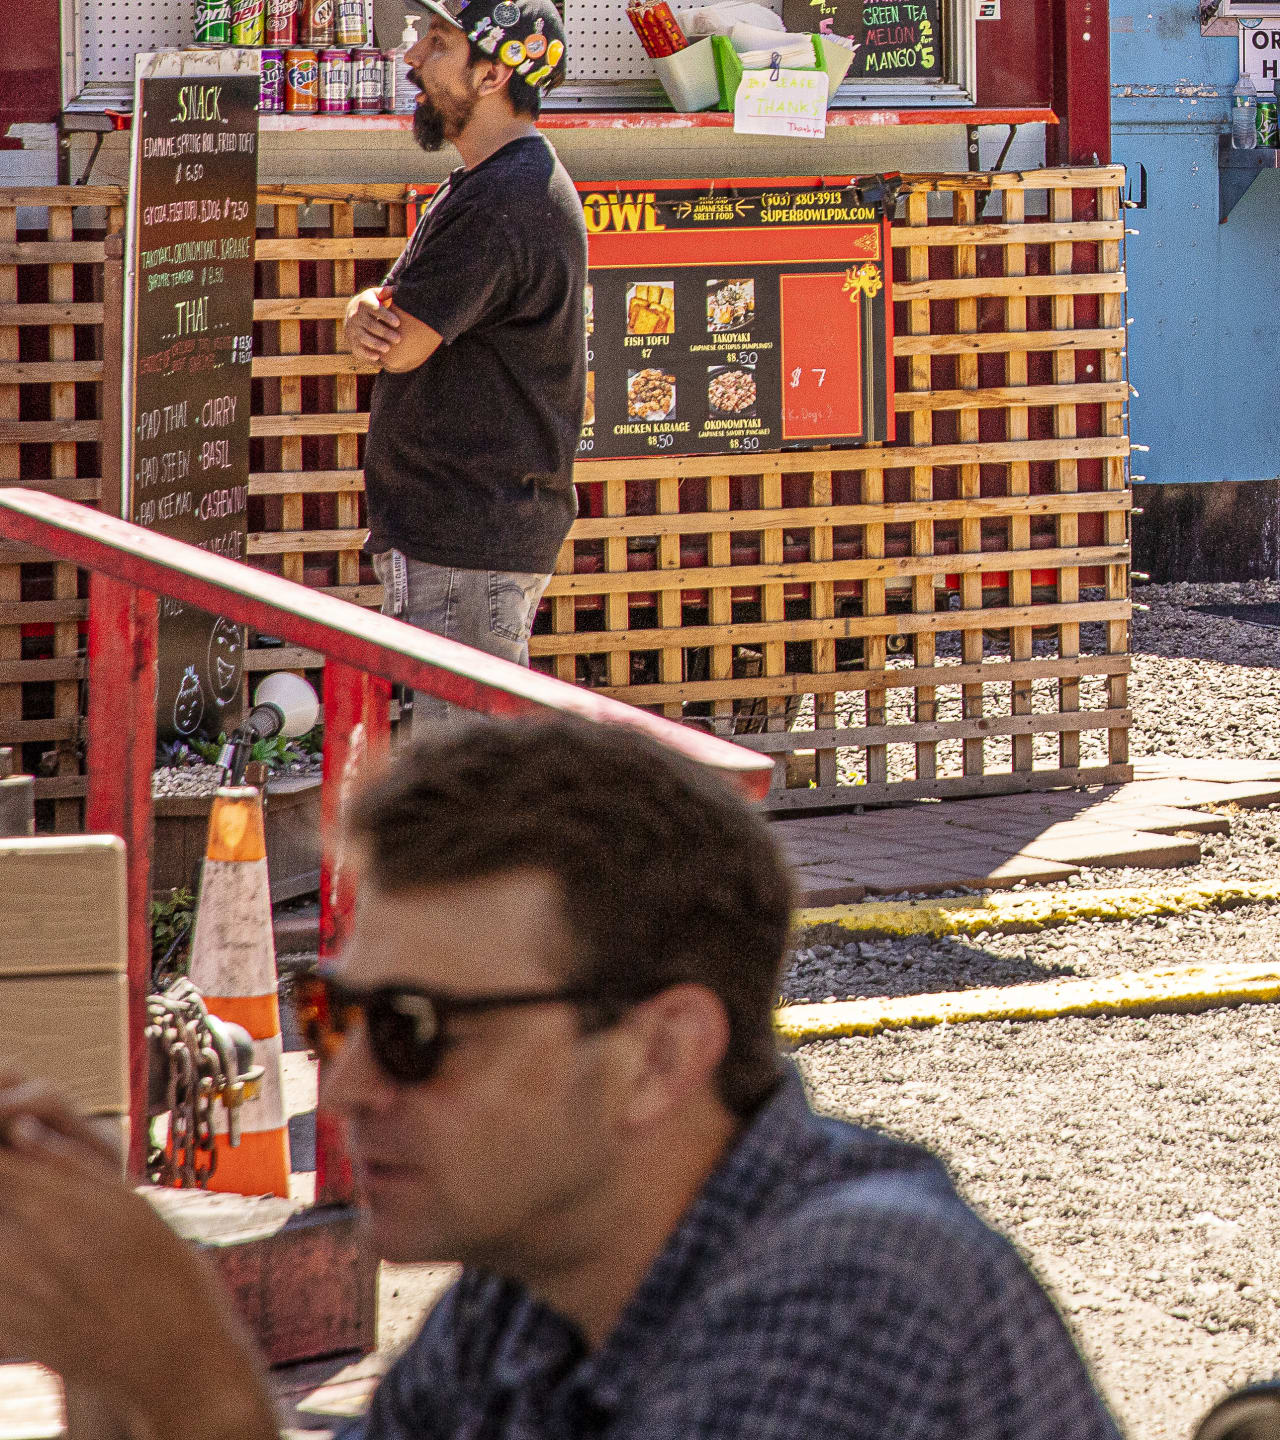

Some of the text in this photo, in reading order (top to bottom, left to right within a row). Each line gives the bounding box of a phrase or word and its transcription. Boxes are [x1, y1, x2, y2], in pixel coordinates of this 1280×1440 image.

[820, 3, 838, 15] for
[863, 4, 928, 26] GREEN TEA
[865, 26, 915, 46] MELON
[919, 19, 933, 36] 2
[865, 48, 917, 72] MANGO
[921, 46, 935, 69] 5
[288, 66, 318, 89] Fant
[178, 84, 222, 122] SNACK
[584, 192, 666, 232] OWL
[715, 212, 734, 220] FOOD
[760, 207, 876, 223] SUPERBOWLPDX.COM
[175, 295, 209, 336] THAI
[623, 335, 670, 347] FISH TOFU
[712, 332, 751, 344] TAKOYAKI
[641, 348, 653, 359] $7
[140, 401, 189, 441] PAD THAI
[202, 395, 238, 428] CURRY
[613, 421, 691, 435] CHICKEN KARAAGE
[703, 418, 762, 431] OKONOMIYAKI
[202, 440, 232, 471] BASIL
